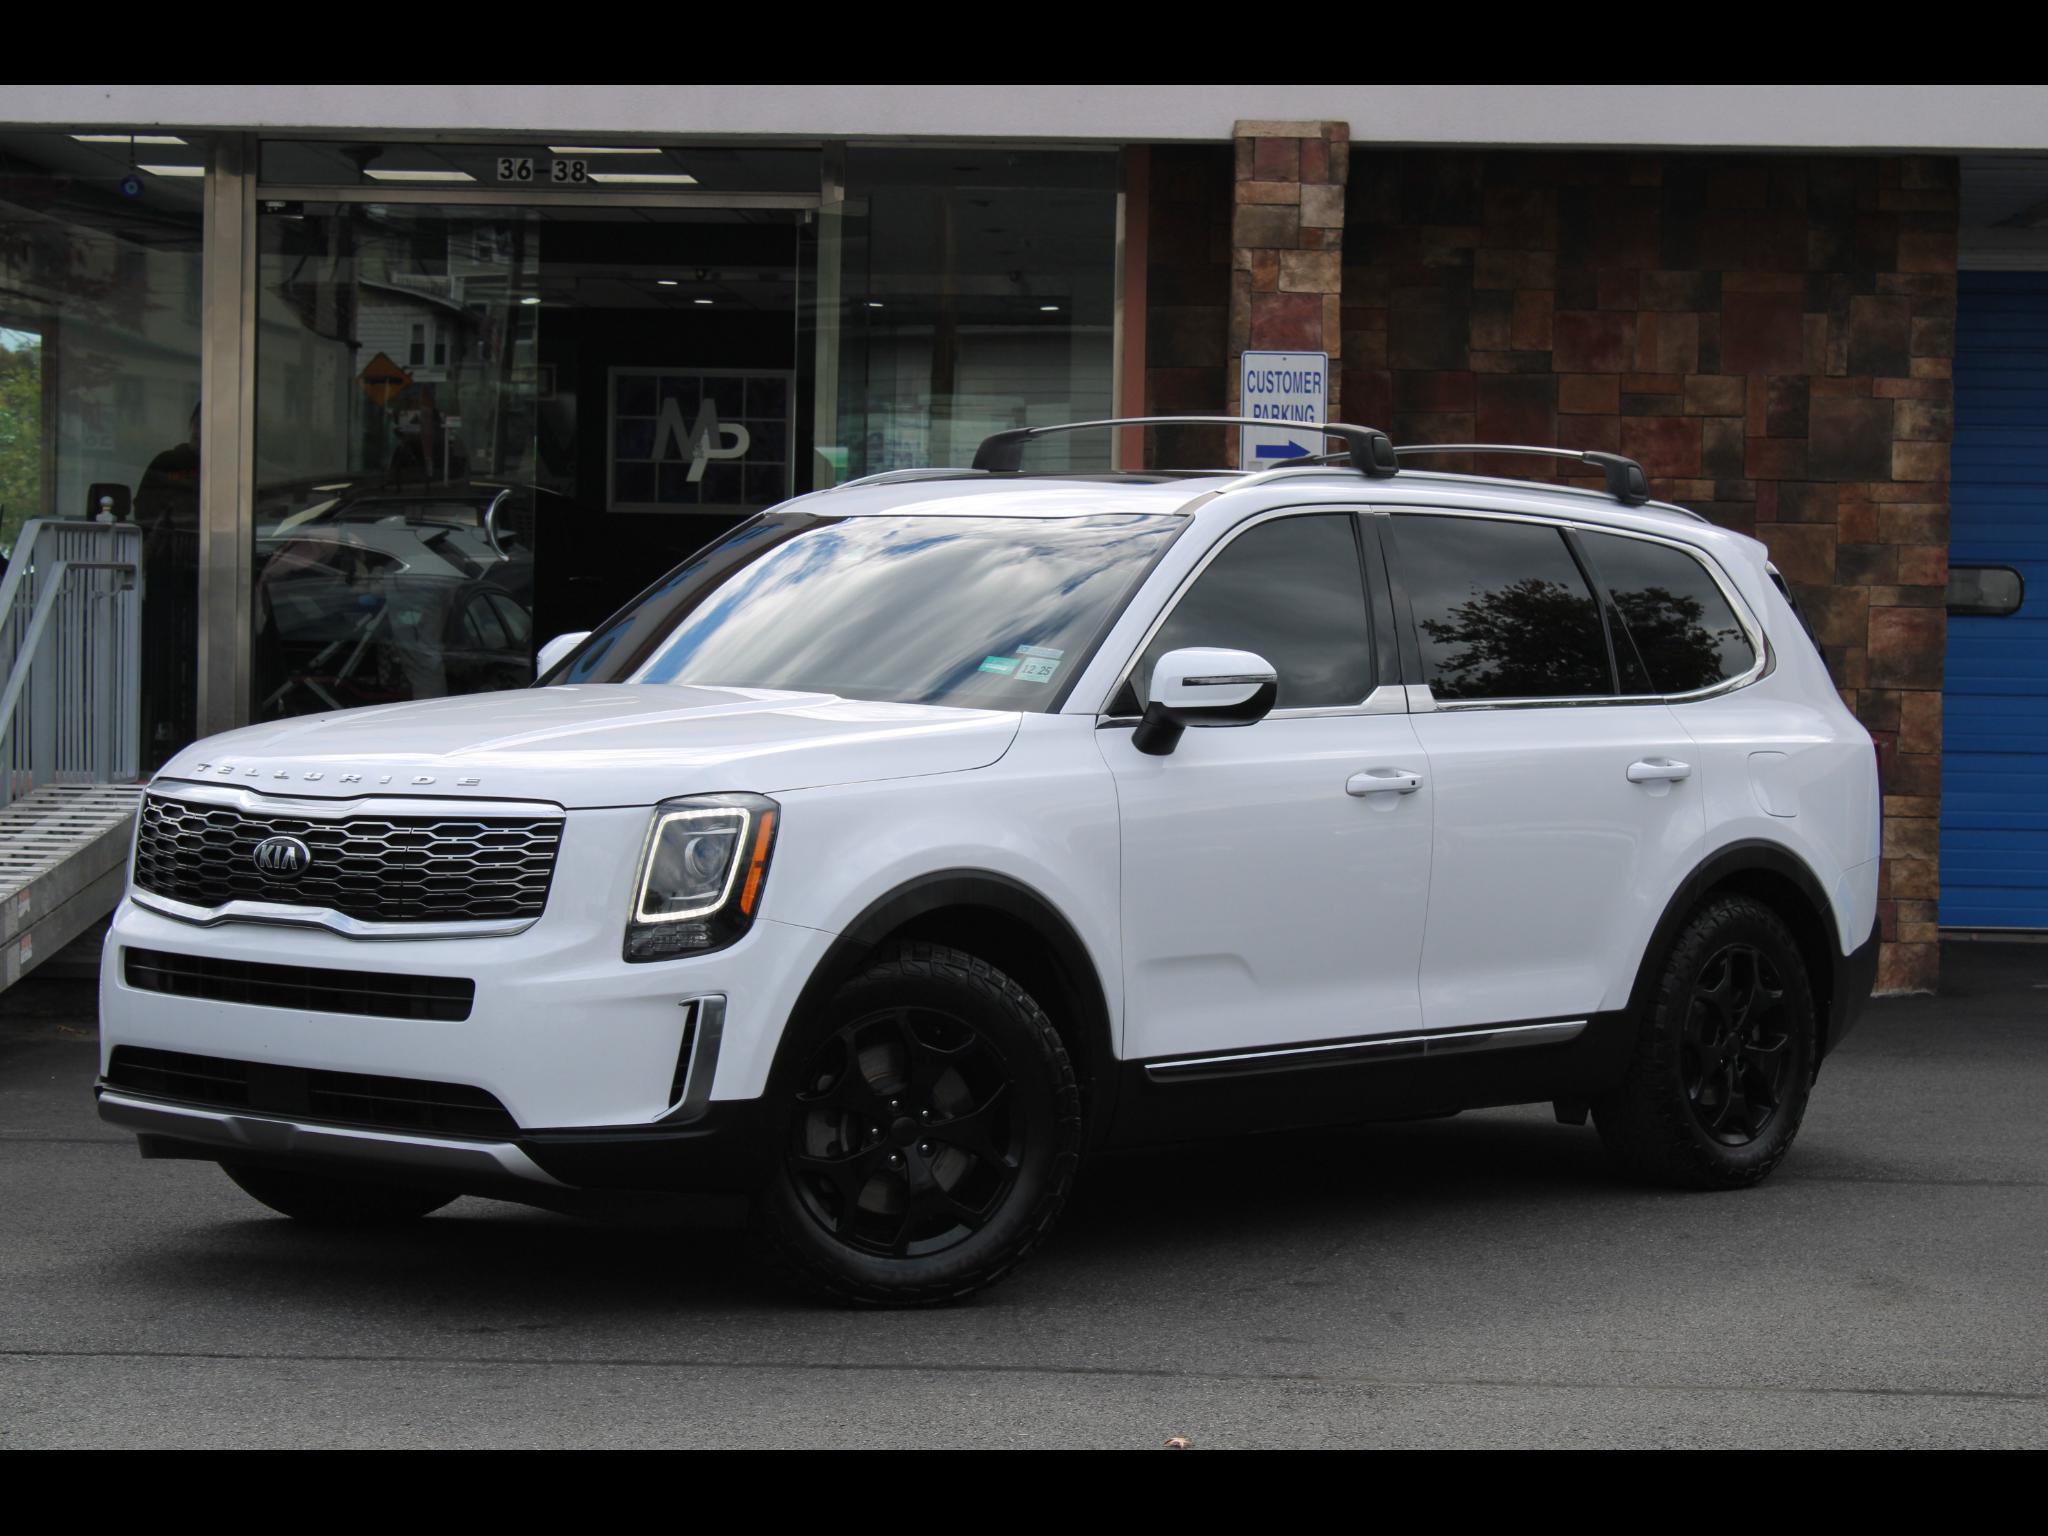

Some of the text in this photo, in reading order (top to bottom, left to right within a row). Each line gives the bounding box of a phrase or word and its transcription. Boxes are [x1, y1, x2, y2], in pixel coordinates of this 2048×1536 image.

[1247, 369, 1322, 394] CUSTOMER
[1253, 403, 1314, 422] PARKING
[1022, 664, 1037, 675] 12
[1038, 665, 1053, 677] 25
[197, 763, 481, 787] TELLURIDE
[260, 844, 297, 870] KIA
